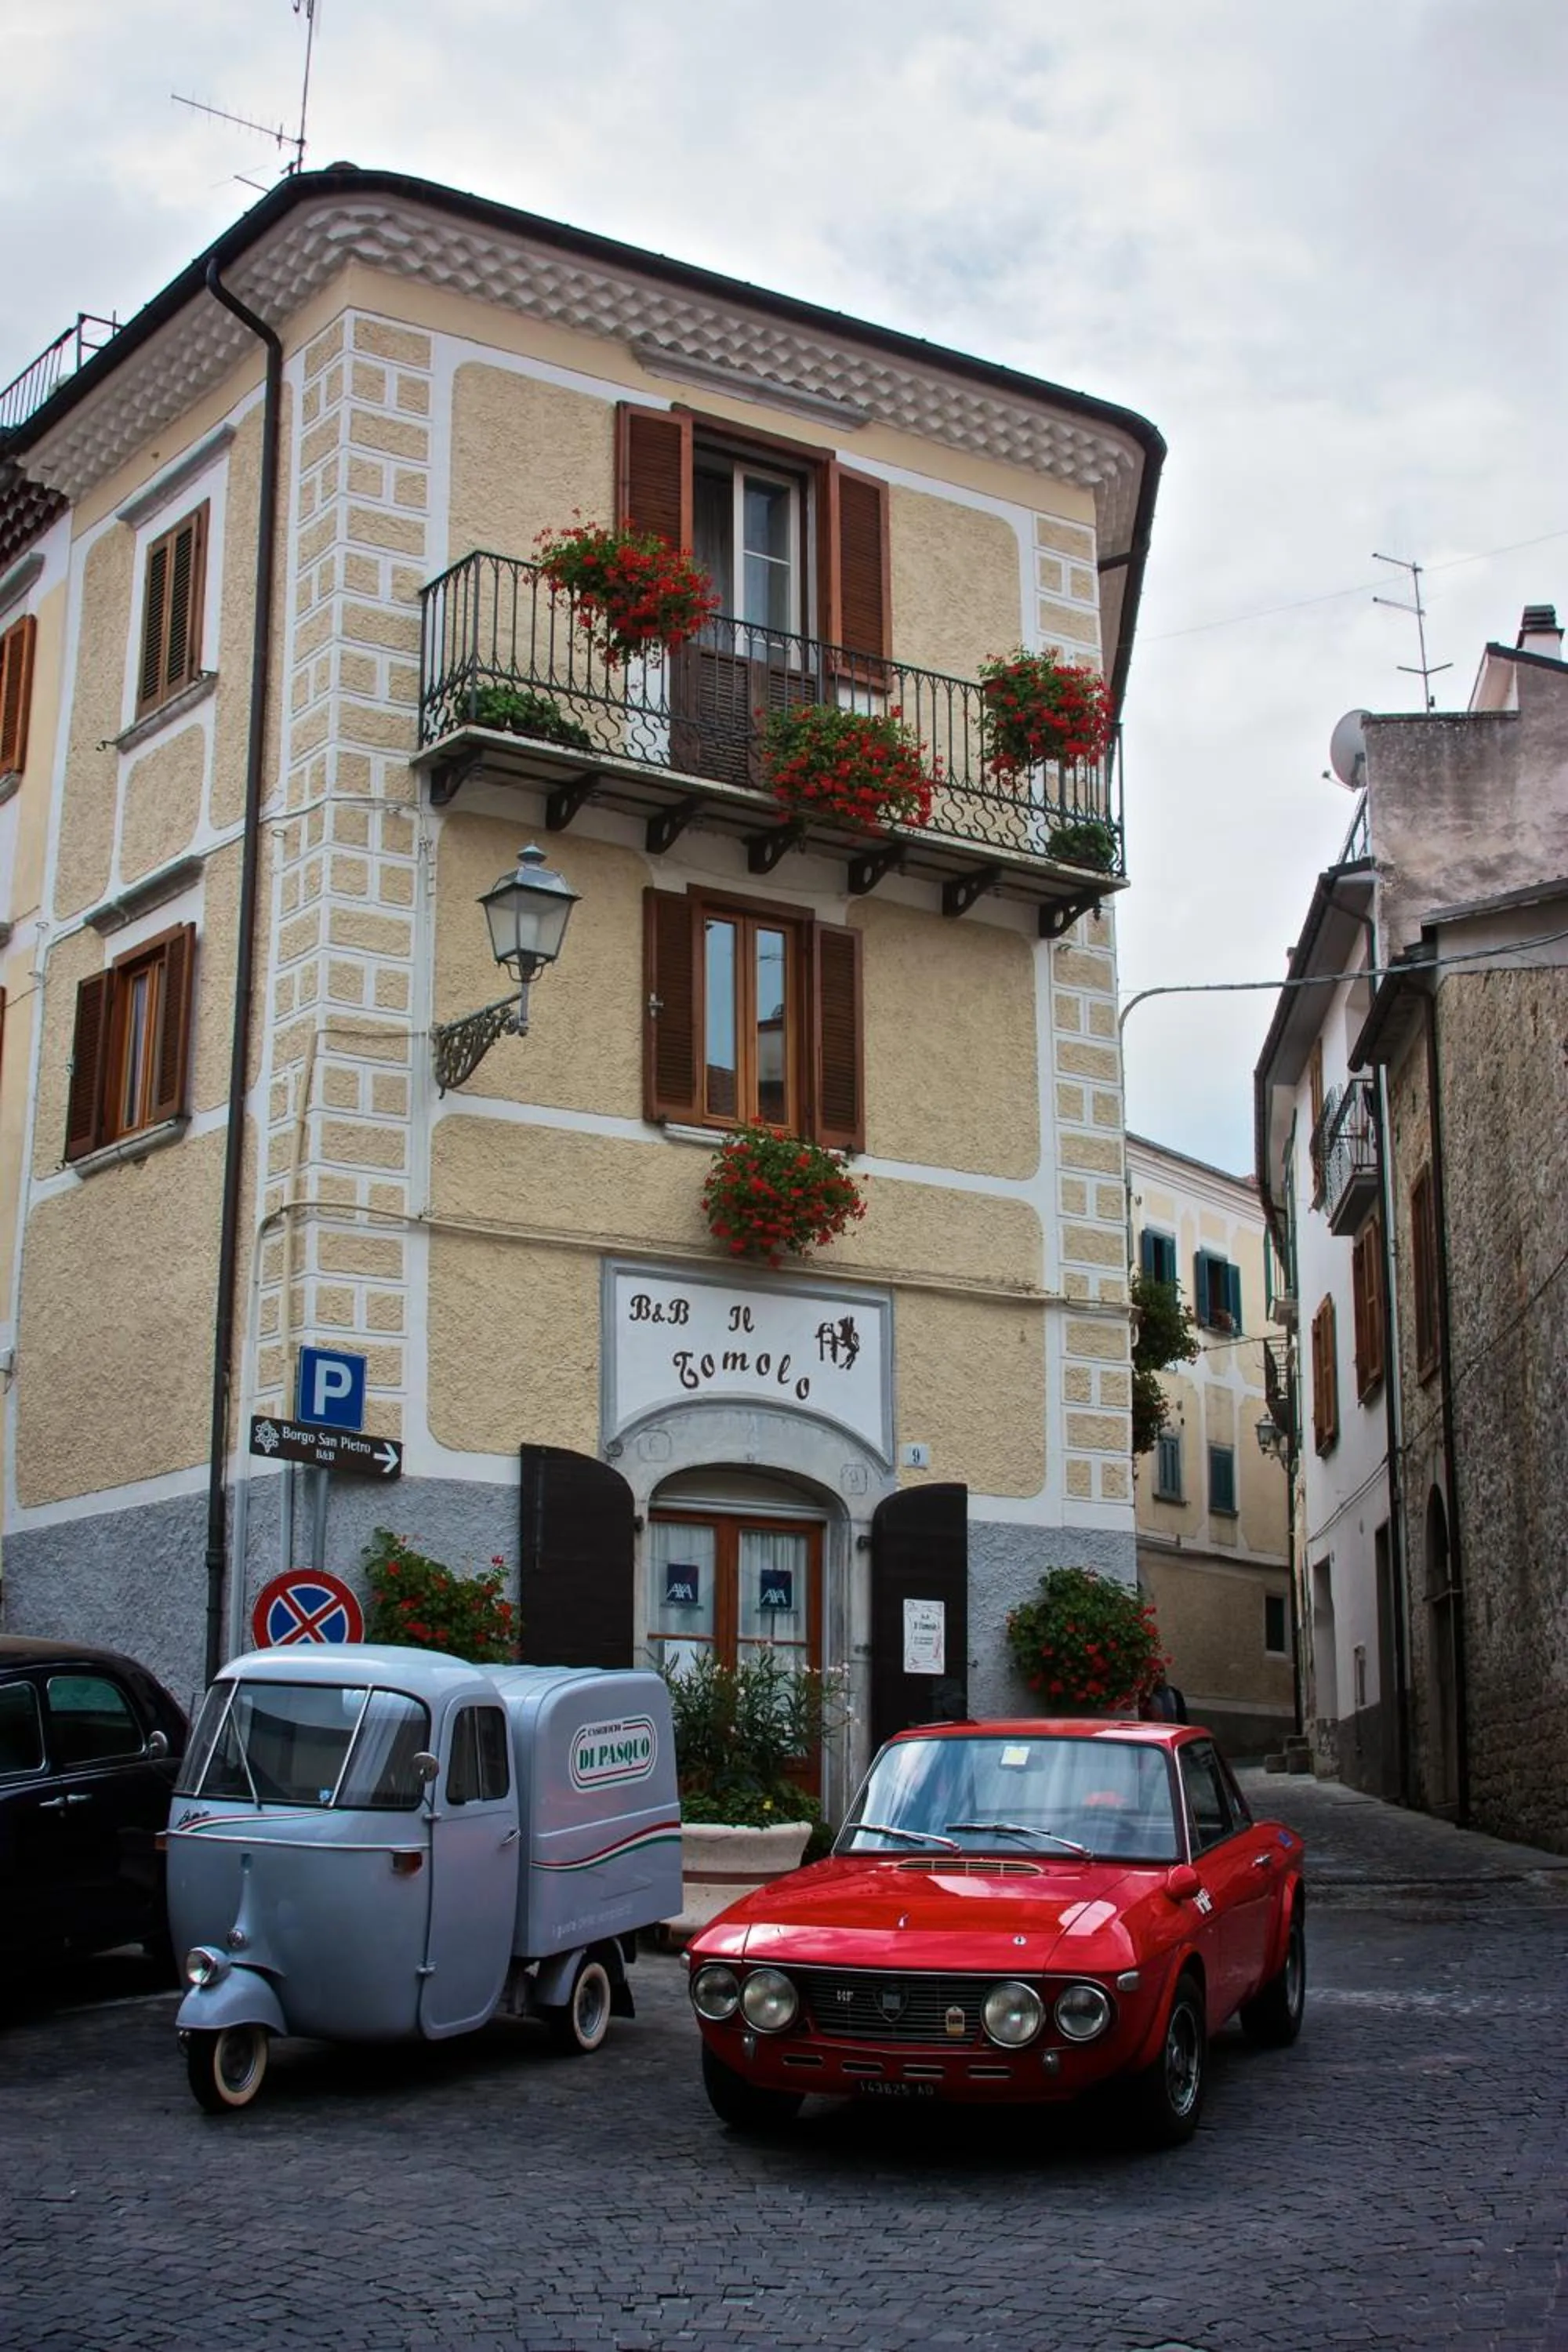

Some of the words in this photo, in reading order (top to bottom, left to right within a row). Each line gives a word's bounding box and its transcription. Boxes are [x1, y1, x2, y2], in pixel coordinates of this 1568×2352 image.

[630, 1294, 689, 1325] B&B
[728, 1305, 755, 1333] Il
[313, 1358, 353, 1415] P
[673, 1349, 810, 1400] Tomolo
[282, 1426, 315, 1446] Borgo
[318, 1432, 338, 1447] San
[340, 1436, 371, 1454] Pietro
[316, 1447, 335, 1461] B&B
[912, 1448, 920, 1465] 9
[667, 1583, 693, 1600] AXA
[760, 1588, 787, 1605] AXA
[579, 1748, 595, 1770] DI
[599, 1737, 650, 1767] PASQUO
